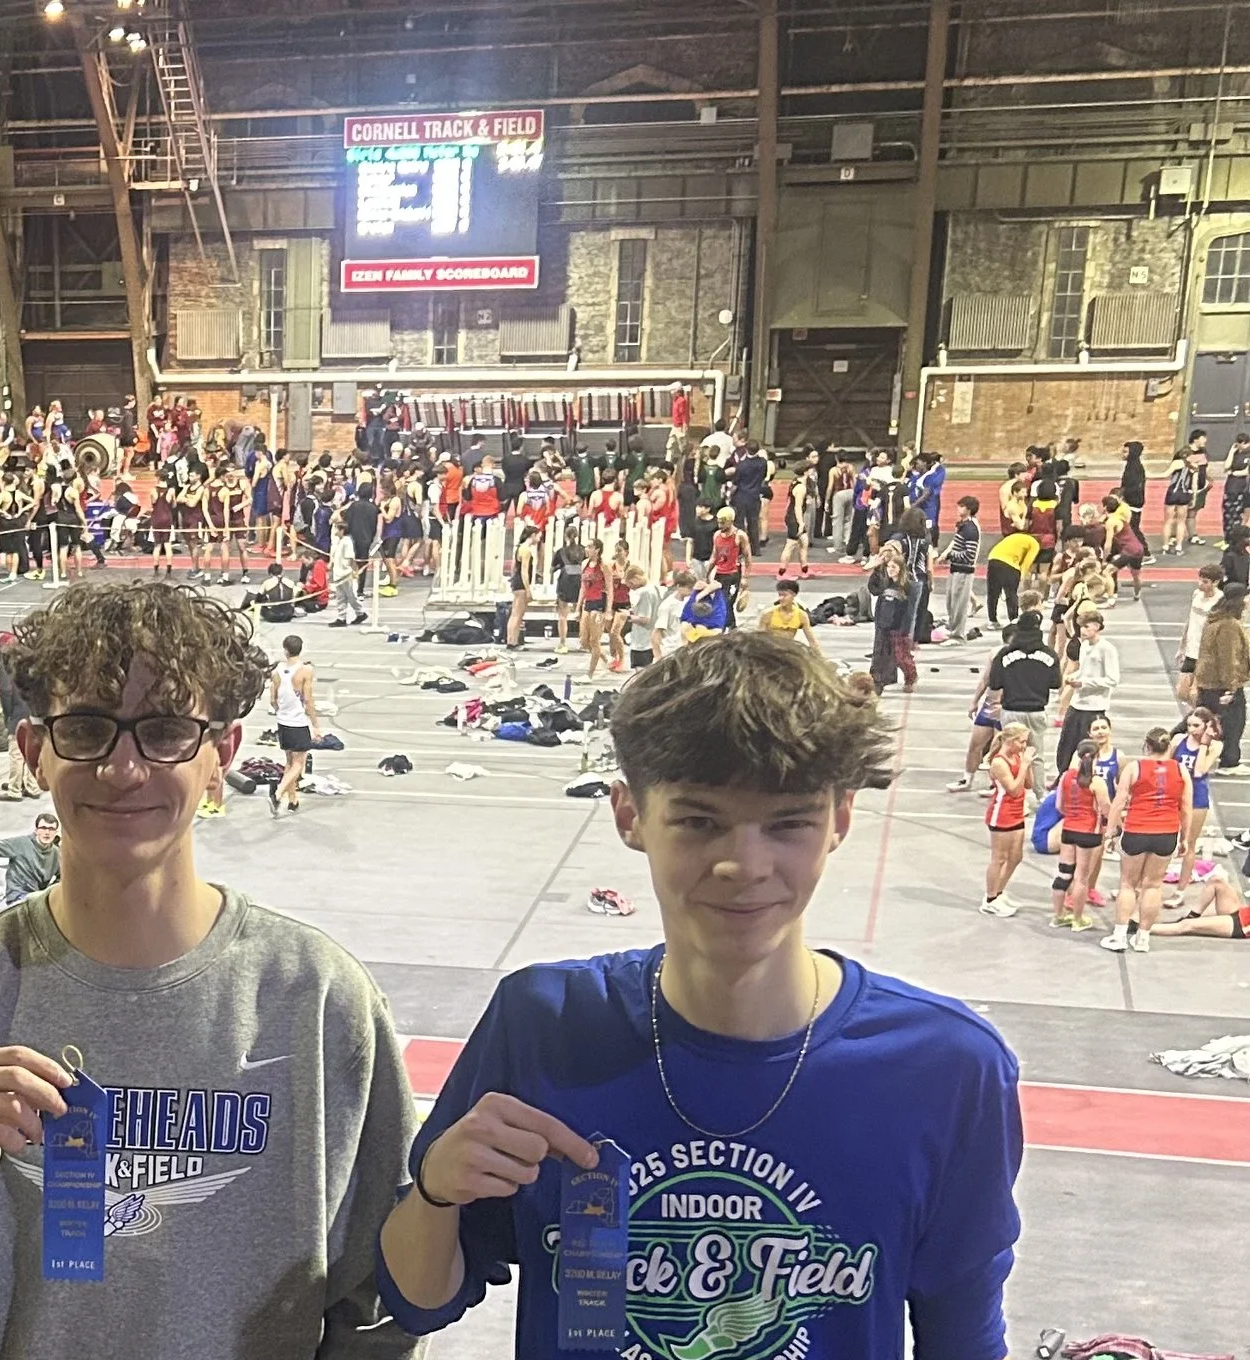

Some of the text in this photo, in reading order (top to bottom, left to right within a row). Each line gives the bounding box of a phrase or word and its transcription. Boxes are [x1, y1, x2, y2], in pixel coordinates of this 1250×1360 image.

[351, 116, 536, 142] CORNELL TRACK & FIELD
[352, 266, 528, 282] IZEN FAMILY SCOREBOARD
[102, 1083, 271, 1154] EHEADS
[670, 1140, 795, 1191] SECTION
[787, 1181, 823, 1214] IV
[661, 1193, 763, 1220] INDOOR
[51, 1259, 95, 1270] 1st PLACE
[689, 1233, 734, 1299] &
[750, 1235, 873, 1300] Field
[568, 1328, 615, 1338] 1st PLACE
